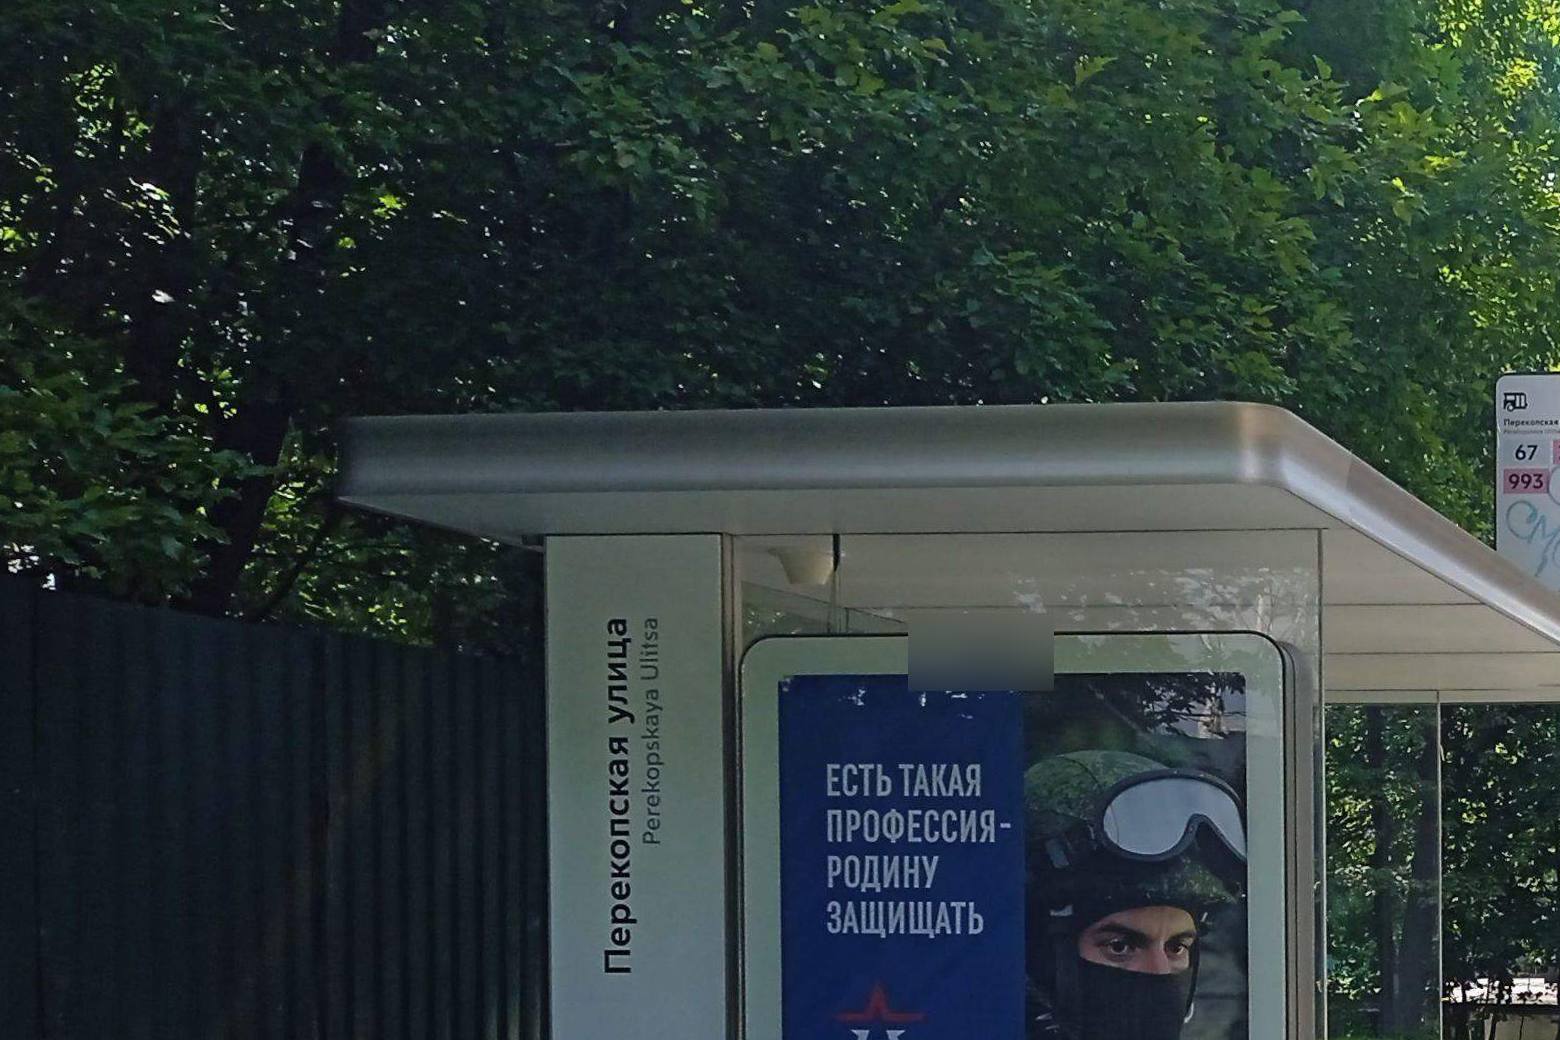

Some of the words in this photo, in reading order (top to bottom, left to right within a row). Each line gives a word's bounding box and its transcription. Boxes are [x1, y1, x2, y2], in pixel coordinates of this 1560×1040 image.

[1515, 444, 1538, 461] 67
[1508, 473, 1544, 490] 993
[638, 617, 659, 681] Ulitsa
[606, 617, 636, 724] улица
[641, 688, 664, 846] Perekopskaya
[826, 763, 893, 797] ЕСТЬ
[898, 763, 982, 797] ТАКАЯ
[604, 736, 638, 975] Перекопская
[826, 855, 940, 893] РОДИНУ
[826, 901, 985, 939] ЗАЩИЩАТЬ
